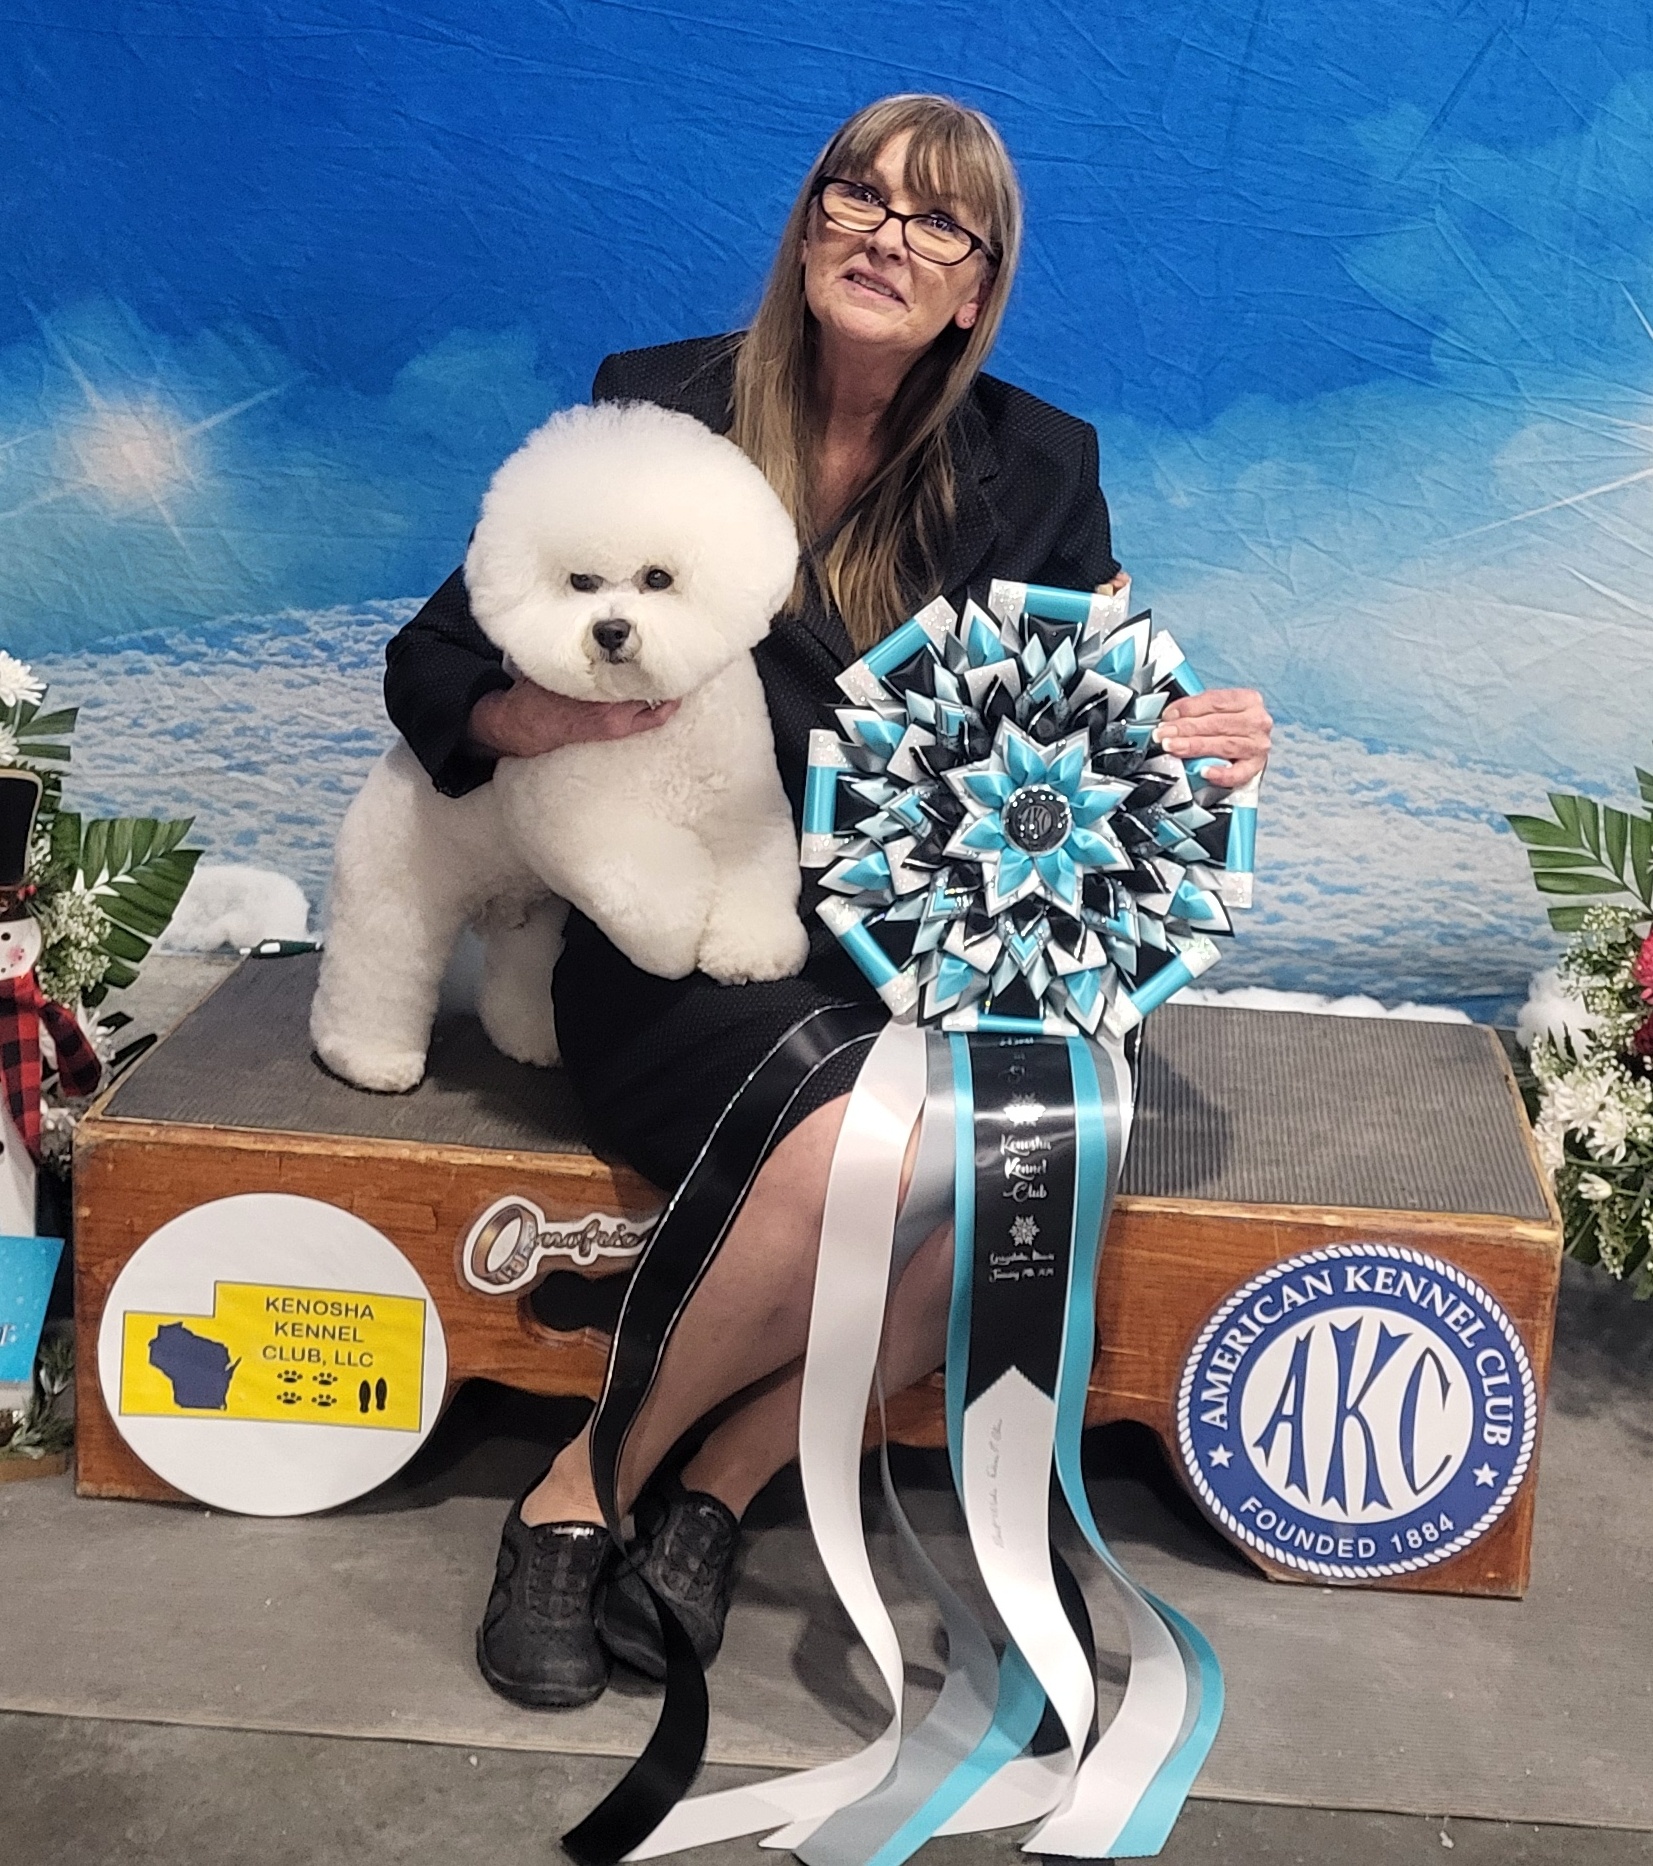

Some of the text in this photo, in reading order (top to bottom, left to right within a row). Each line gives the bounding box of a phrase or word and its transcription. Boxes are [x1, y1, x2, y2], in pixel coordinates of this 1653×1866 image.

[1004, 1157, 1047, 1180] Kennel
[1003, 1181, 1048, 1203] Club
[265, 1296, 375, 1321] KENOSHA
[274, 1321, 365, 1343] KENNEL
[262, 1345, 374, 1368] CLUB, LLC
[1200, 1264, 1514, 1448] AMERICAN KENNEL CLUB
[1252, 1315, 1453, 1517] AKC
[1239, 1495, 1455, 1559] FOUNDED 1884
